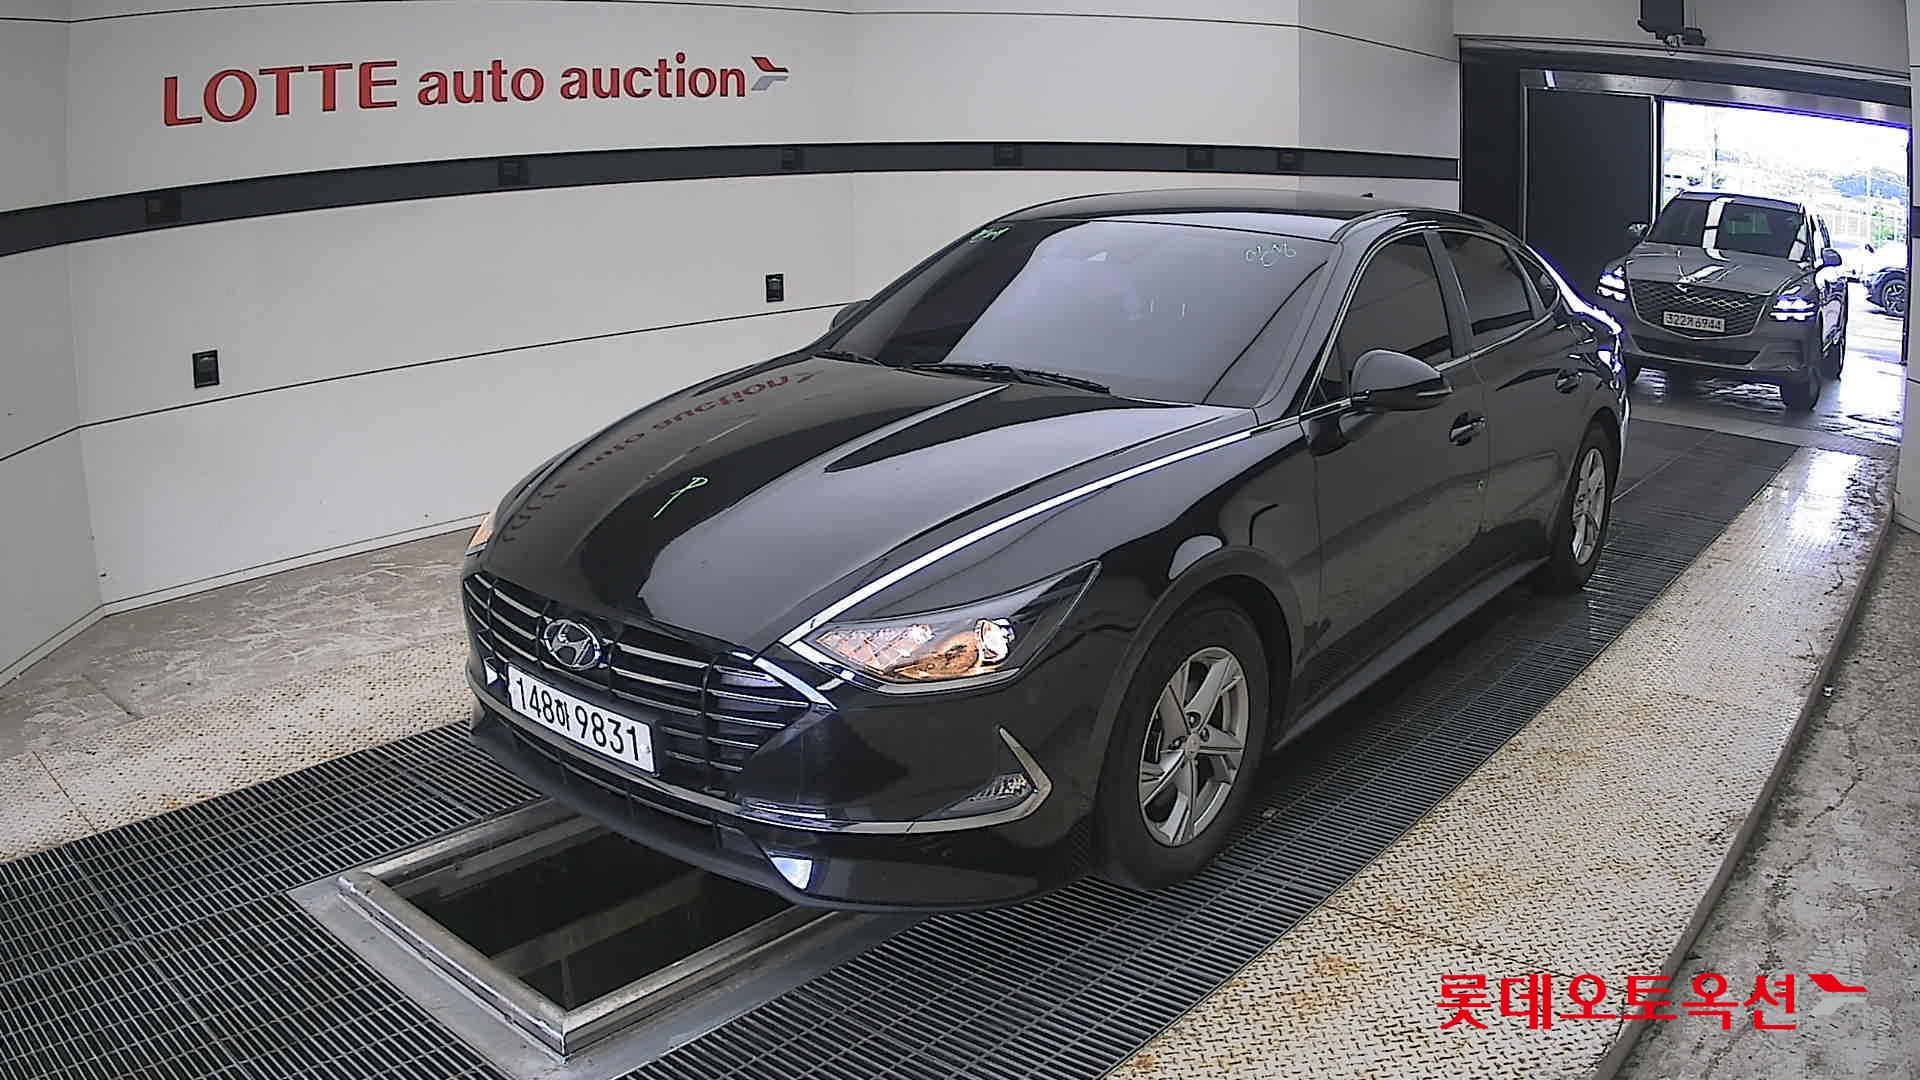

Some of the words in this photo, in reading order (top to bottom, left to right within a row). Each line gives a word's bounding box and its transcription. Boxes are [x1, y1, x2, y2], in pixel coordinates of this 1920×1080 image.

[164, 60, 398, 127] LOTTE
[417, 59, 545, 106] auto
[560, 51, 747, 99] auction
[574, 704, 640, 762] 9831
